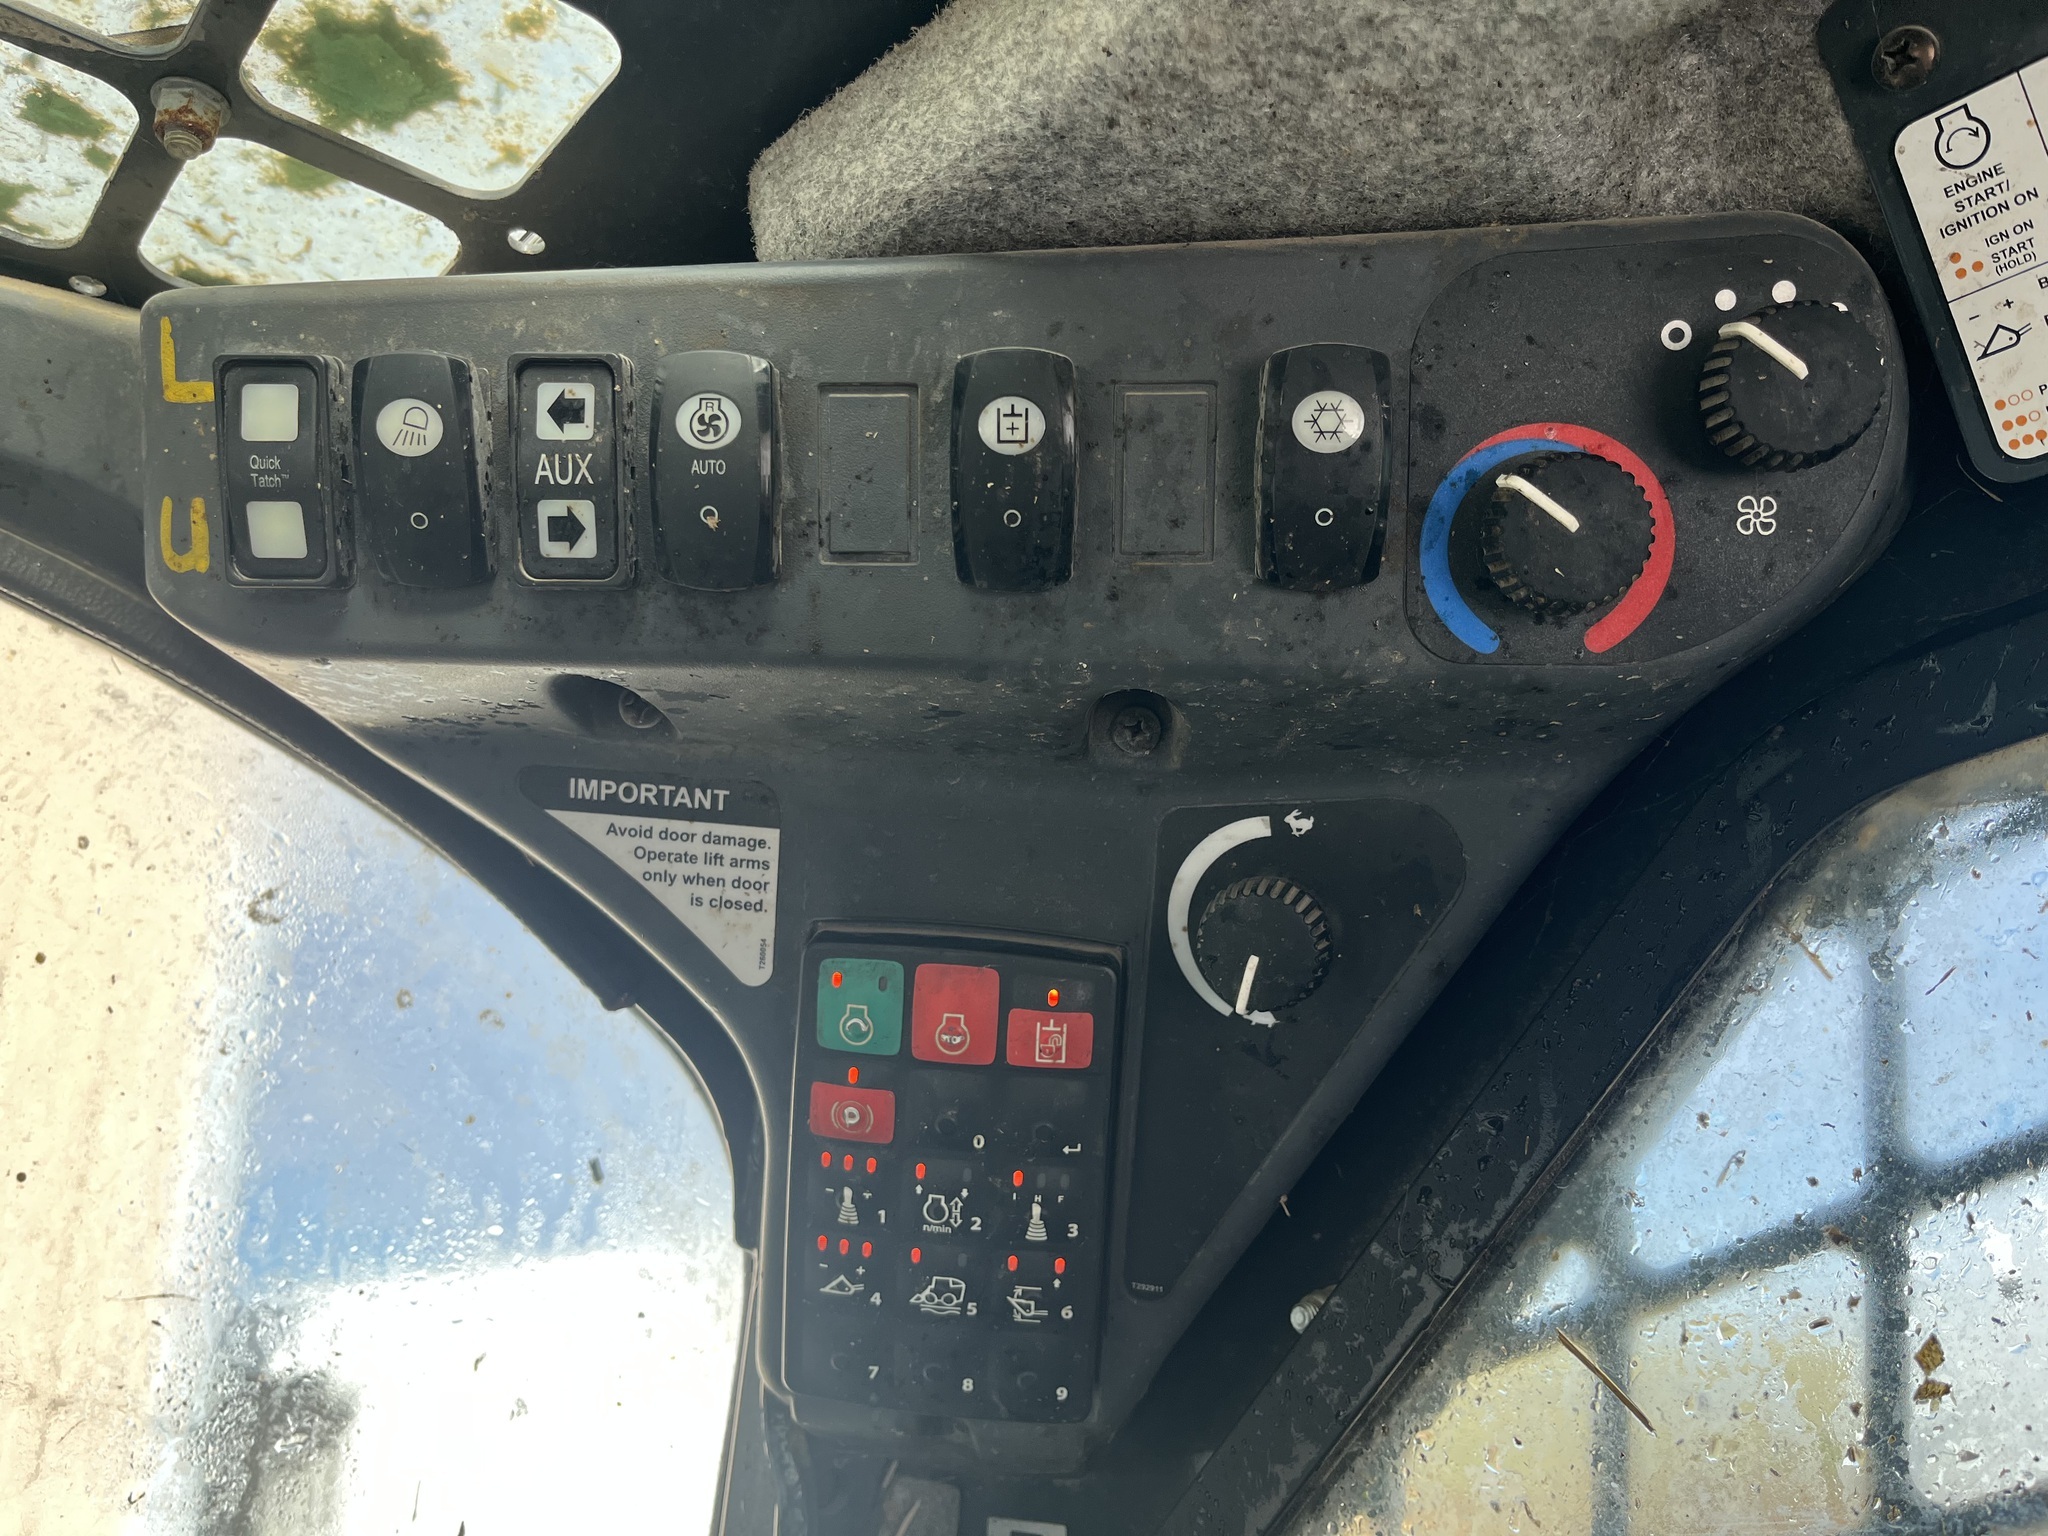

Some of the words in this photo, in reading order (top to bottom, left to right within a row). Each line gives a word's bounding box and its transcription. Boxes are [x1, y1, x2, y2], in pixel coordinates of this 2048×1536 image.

[1943, 162, 2005, 199] ENGINE
[1954, 179, 2010, 213] START/
[1939, 200, 2010, 239] IGNITION
[2014, 187, 2039, 206] ON
[1984, 229, 2010, 248] IGN
[2013, 219, 2034, 236] ON
[1991, 237, 2035, 264] START
[1995, 251, 2037, 276] (HOLD)
[160, 316, 215, 403] L
[705, 401, 715, 412] R
[250, 454, 281, 470] Quick
[534, 453, 594, 485] AUX
[691, 459, 726, 476] AUTO
[569, 778, 730, 811] IMPORTANT
[606, 822, 653, 839] Avoid
[659, 827, 697, 844] door
[702, 831, 771, 851] damage.
[634, 846, 698, 864] Operate
[704, 852, 725, 867] lift
[729, 856, 770, 870] arms
[642, 868, 677, 886] only
[682, 872, 726, 888] when
[731, 876, 770, 892] door
[690, 893, 703, 907] is
[709, 895, 768, 913] closed.
[973, 1134, 985, 1149] 0
[1034, 1194, 1042, 1203] H
[1057, 1195, 1065, 1203] F
[878, 1209, 886, 1224] 1
[970, 1216, 982, 1231] 2
[922, 1223, 952, 1234] n/min
[1067, 1223, 1079, 1238] 3
[870, 1292, 882, 1305] 4
[966, 1303, 977, 1316] 5
[1061, 1305, 1073, 1319] 6
[868, 1365, 880, 1379] 7
[962, 1378, 974, 1392] 8
[1056, 1386, 1068, 1400] 9
